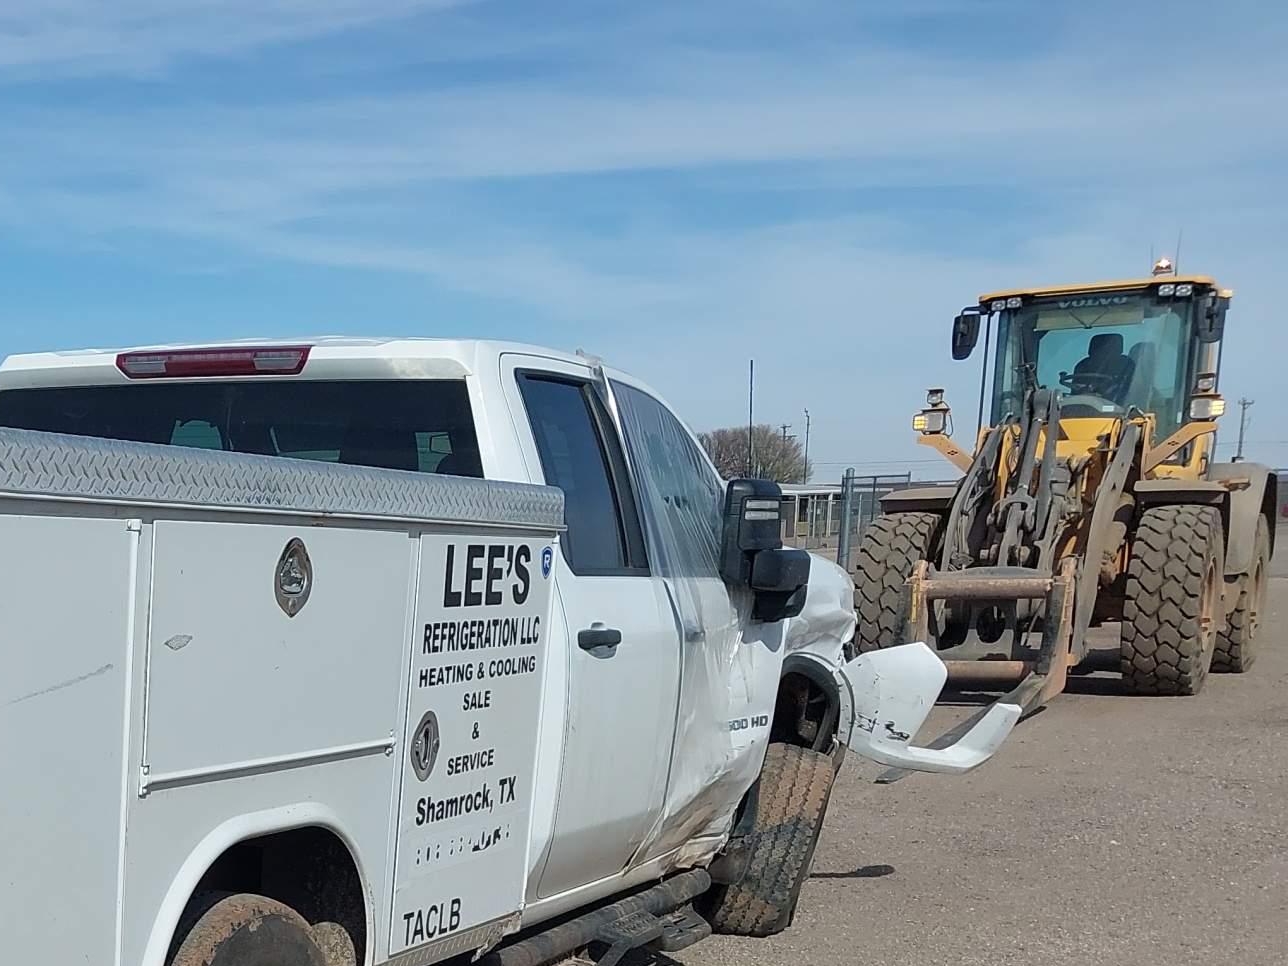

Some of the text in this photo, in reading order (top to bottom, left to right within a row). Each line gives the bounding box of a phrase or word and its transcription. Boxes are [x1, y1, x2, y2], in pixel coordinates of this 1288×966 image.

[1056, 296, 1128, 309] VOLVO
[443, 544, 531, 608] LEE'S
[422, 615, 540, 655] REFRIGERATION LLC
[418, 655, 536, 688] HEATING & COOLING
[462, 690, 491, 711] SALE
[471, 722, 480, 740] &
[751, 714, 769, 728] HD
[447, 748, 495, 776] SERVICE
[415, 775, 517, 826] Shamrock, TX
[403, 897, 461, 947] TACLB
